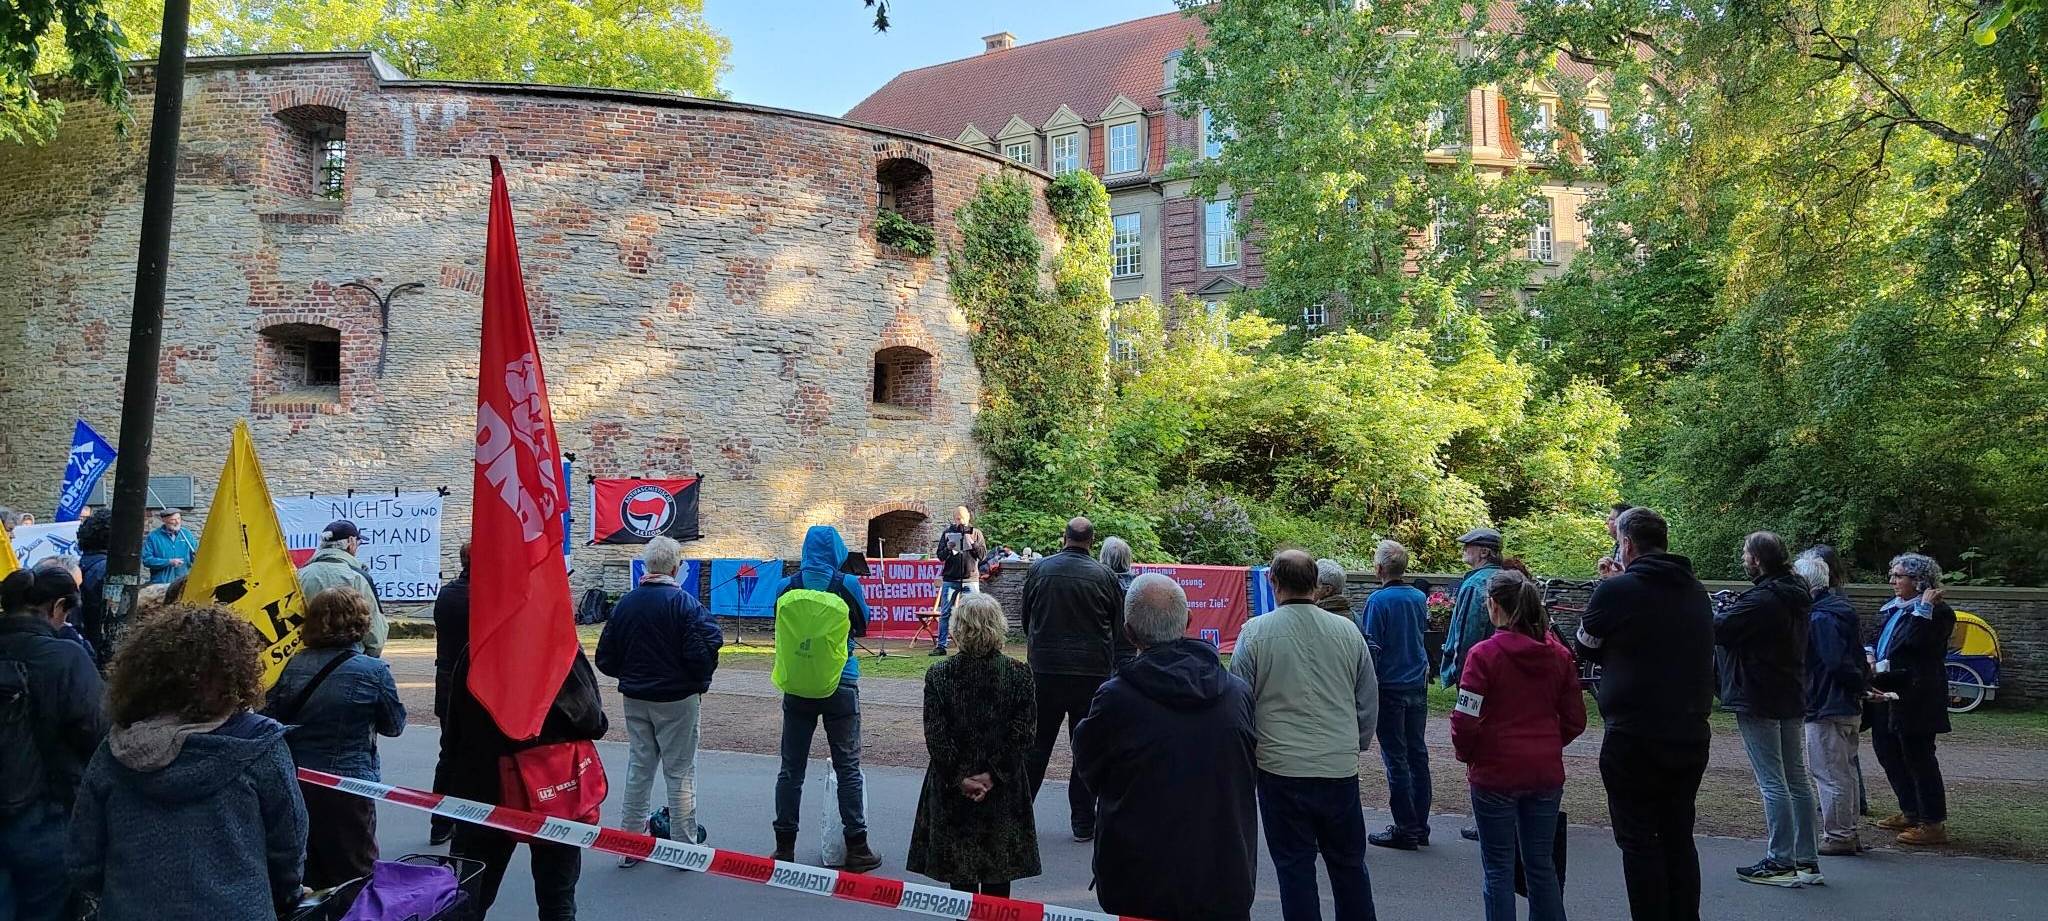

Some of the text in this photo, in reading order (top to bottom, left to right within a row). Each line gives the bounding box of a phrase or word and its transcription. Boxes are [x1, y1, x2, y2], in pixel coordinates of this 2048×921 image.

[60, 452, 101, 508] DFG-VK
[331, 499, 438, 519] NICHTS UND
[359, 527, 431, 545] EMAND
[635, 529, 662, 537] AKTION
[370, 554, 403, 570] IST
[888, 564, 915, 580] UND
[917, 564, 944, 580] NAZ
[374, 582, 438, 598] GESSEN
